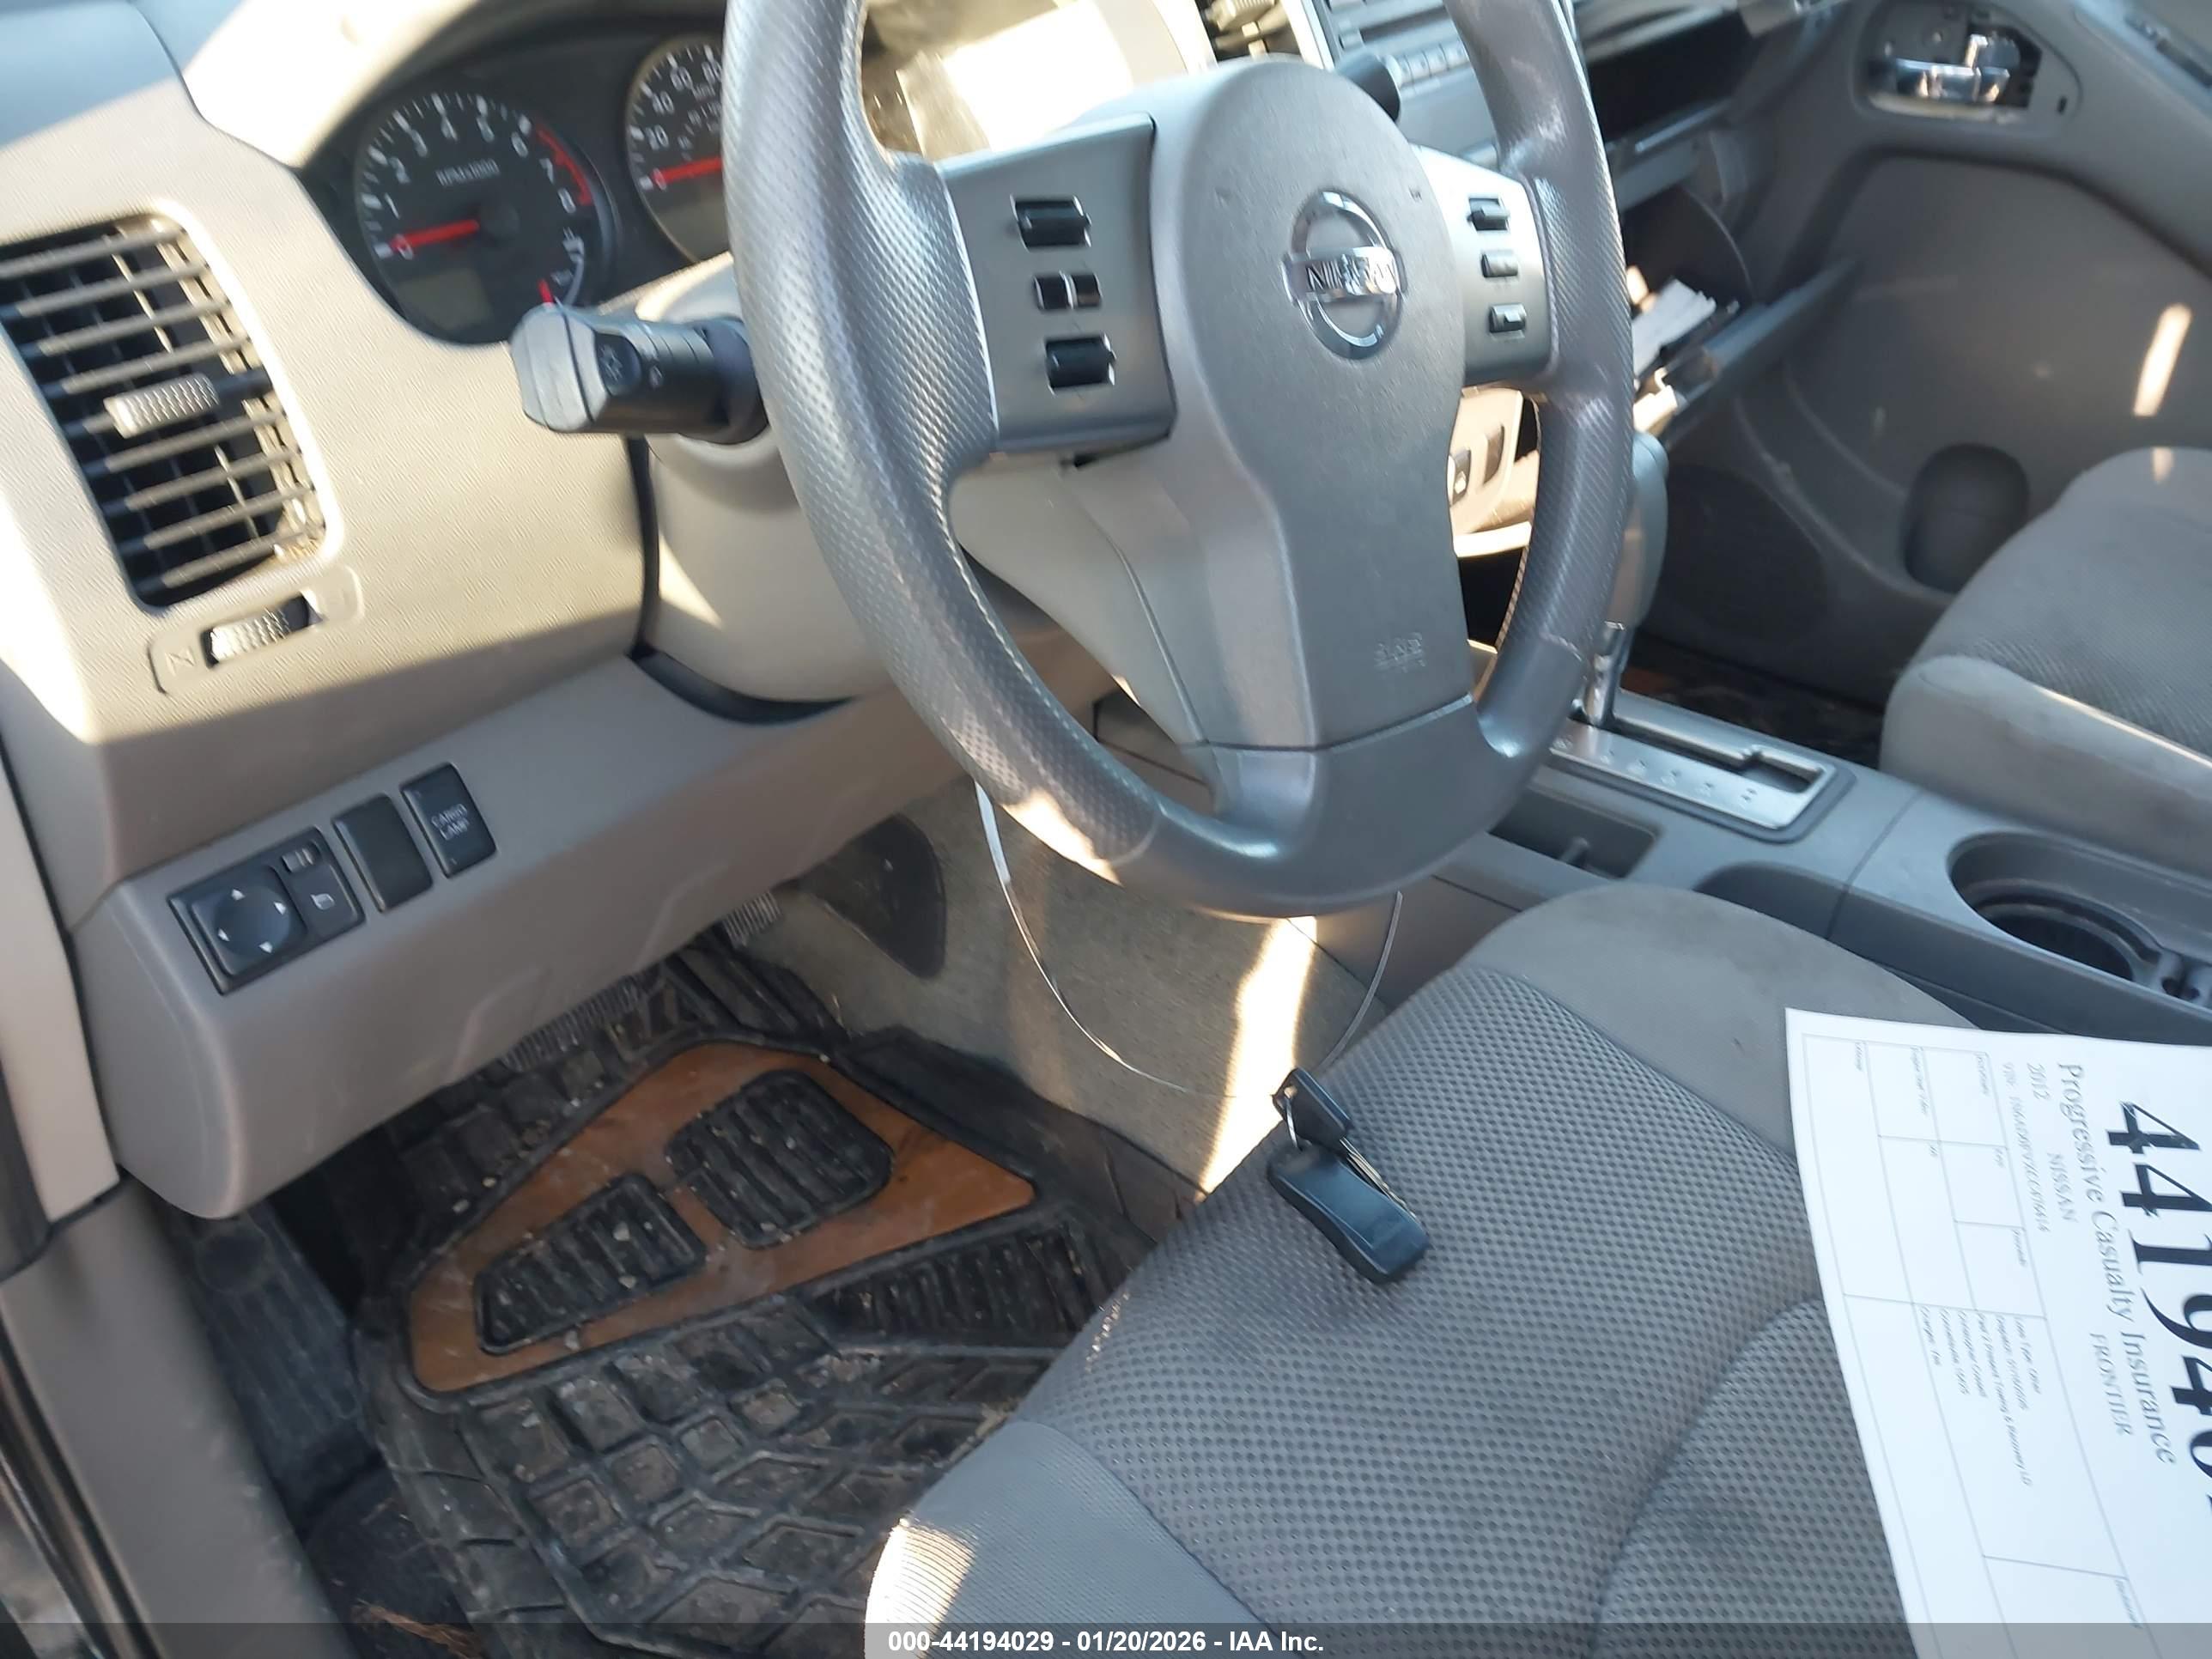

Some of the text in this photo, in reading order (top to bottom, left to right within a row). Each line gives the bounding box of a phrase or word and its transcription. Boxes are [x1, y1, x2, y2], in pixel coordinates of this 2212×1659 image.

[670, 66, 692, 91] 60
[653, 90, 675, 114] 40
[440, 116, 458, 141] 4
[476, 115, 495, 143] 5
[646, 125, 670, 149] 20
[408, 129, 428, 157] 3
[511, 131, 529, 158] 6
[389, 157, 410, 184] 2
[539, 157, 555, 185] 7
[384, 192, 400, 219] 1
[558, 188, 576, 214] 8
[2027, 1064, 2134, 1436] 2012 NISSAN FRONTIER
[2058, 1064, 2177, 1464] Progressive Casualty Insurance
